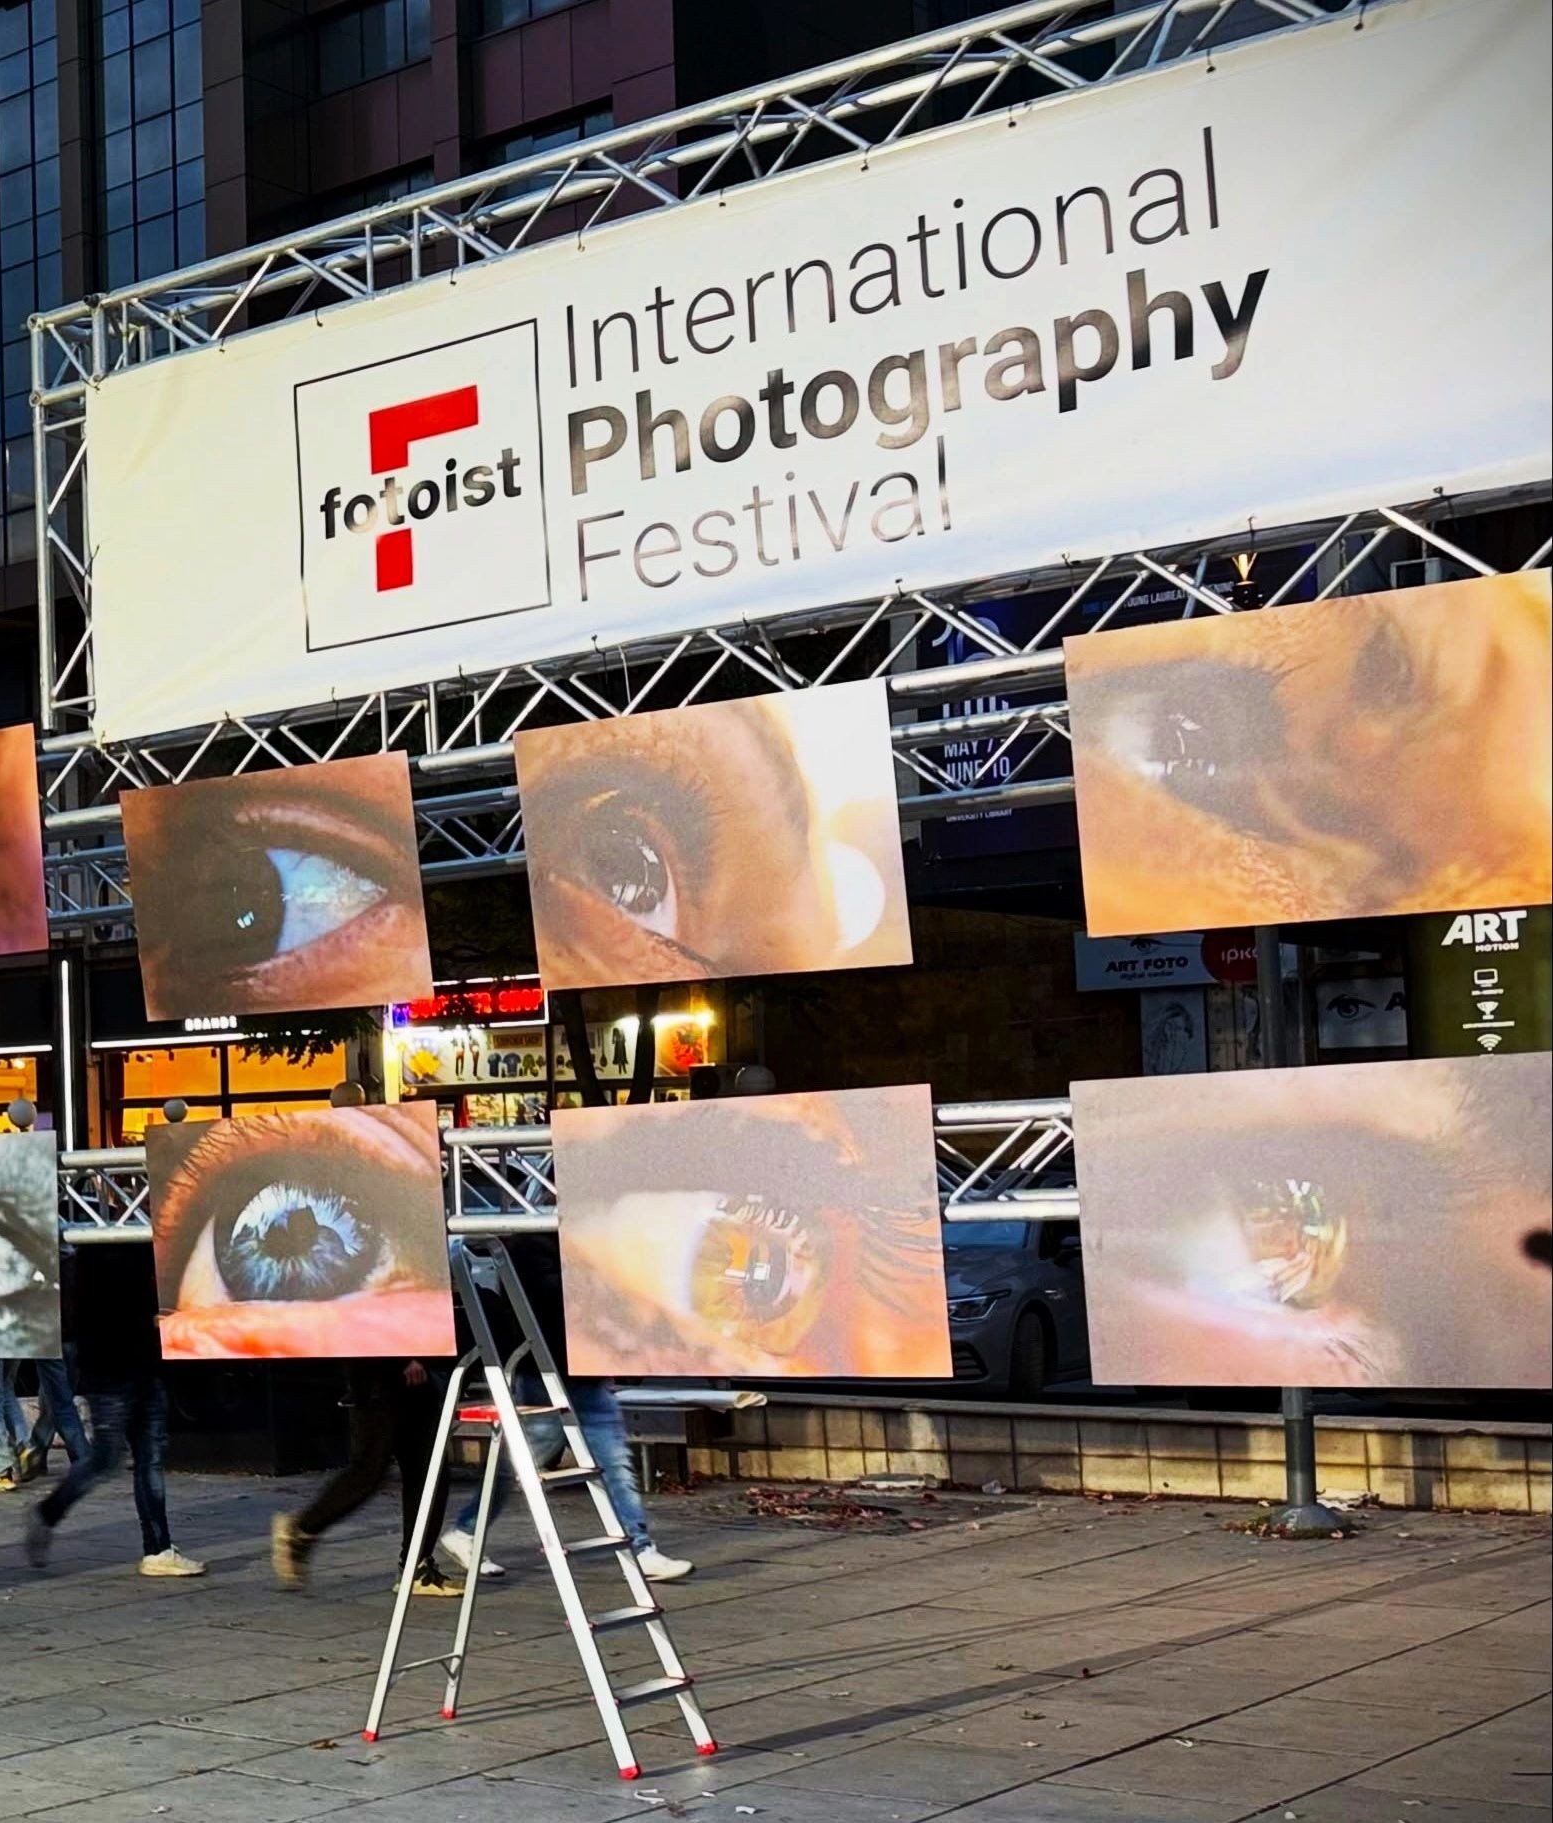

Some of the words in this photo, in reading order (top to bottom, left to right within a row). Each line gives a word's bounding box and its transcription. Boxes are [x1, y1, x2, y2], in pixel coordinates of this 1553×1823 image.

[566, 126, 1220, 389] International
[567, 268, 1270, 497] Photography
[321, 445, 523, 541] fotoist
[576, 435, 955, 603] Festival
[944, 740, 978, 758] MAY
[992, 756, 1011, 779] 10
[1441, 910, 1527, 947] ART
[1105, 960, 1139, 973] ART
[1143, 956, 1189, 970] FOTO
[1475, 942, 1519, 953] MOTION
